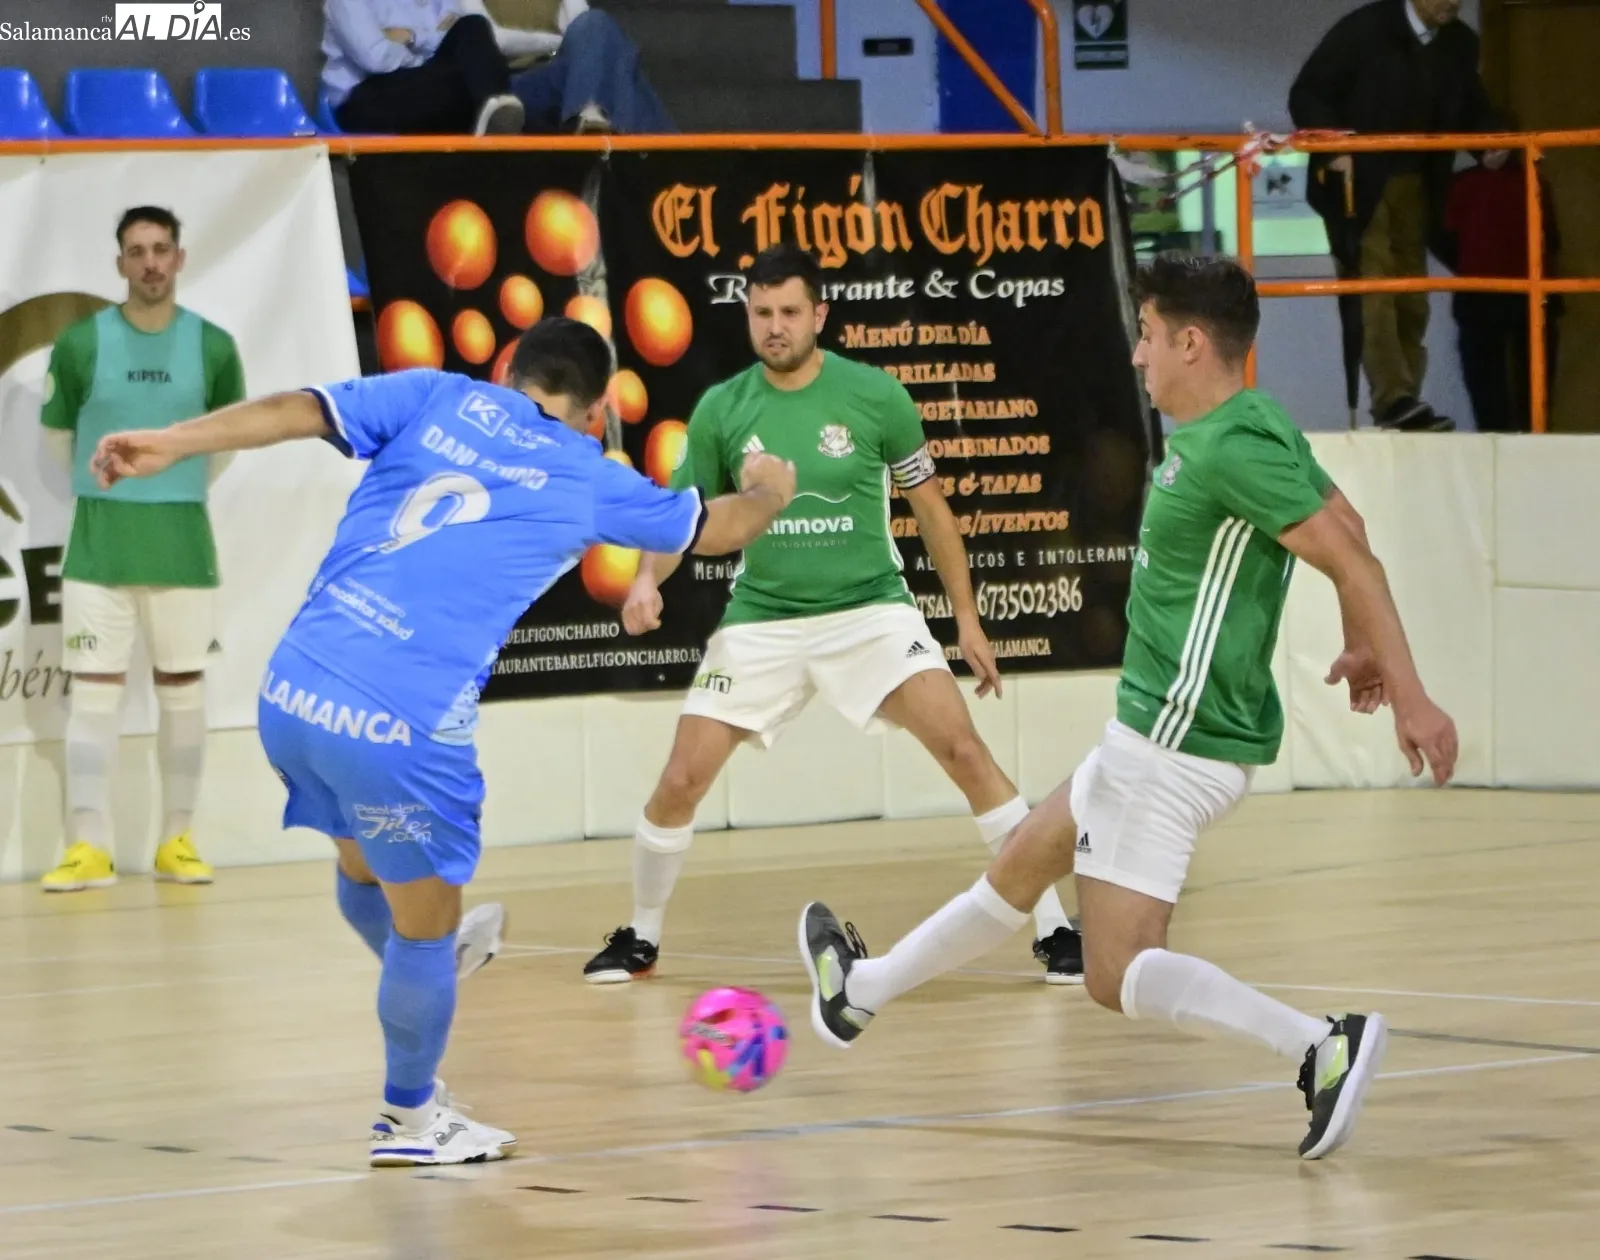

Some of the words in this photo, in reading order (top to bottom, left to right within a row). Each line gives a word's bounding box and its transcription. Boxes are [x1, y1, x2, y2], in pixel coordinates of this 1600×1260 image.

[652, 183, 720, 258] El
[740, 173, 912, 269] Figón
[919, 182, 1105, 267] Charro
[925, 268, 958, 297] &
[969, 270, 1065, 306] Copas
[918, 325, 957, 345] DEL
[127, 370, 173, 383] KIPSTA
[421, 424, 479, 466] DANI
[979, 473, 1042, 495] TAPAS
[767, 515, 854, 535] innova
[1017, 551, 1026, 567] E
[976, 576, 1083, 621] 673502386
